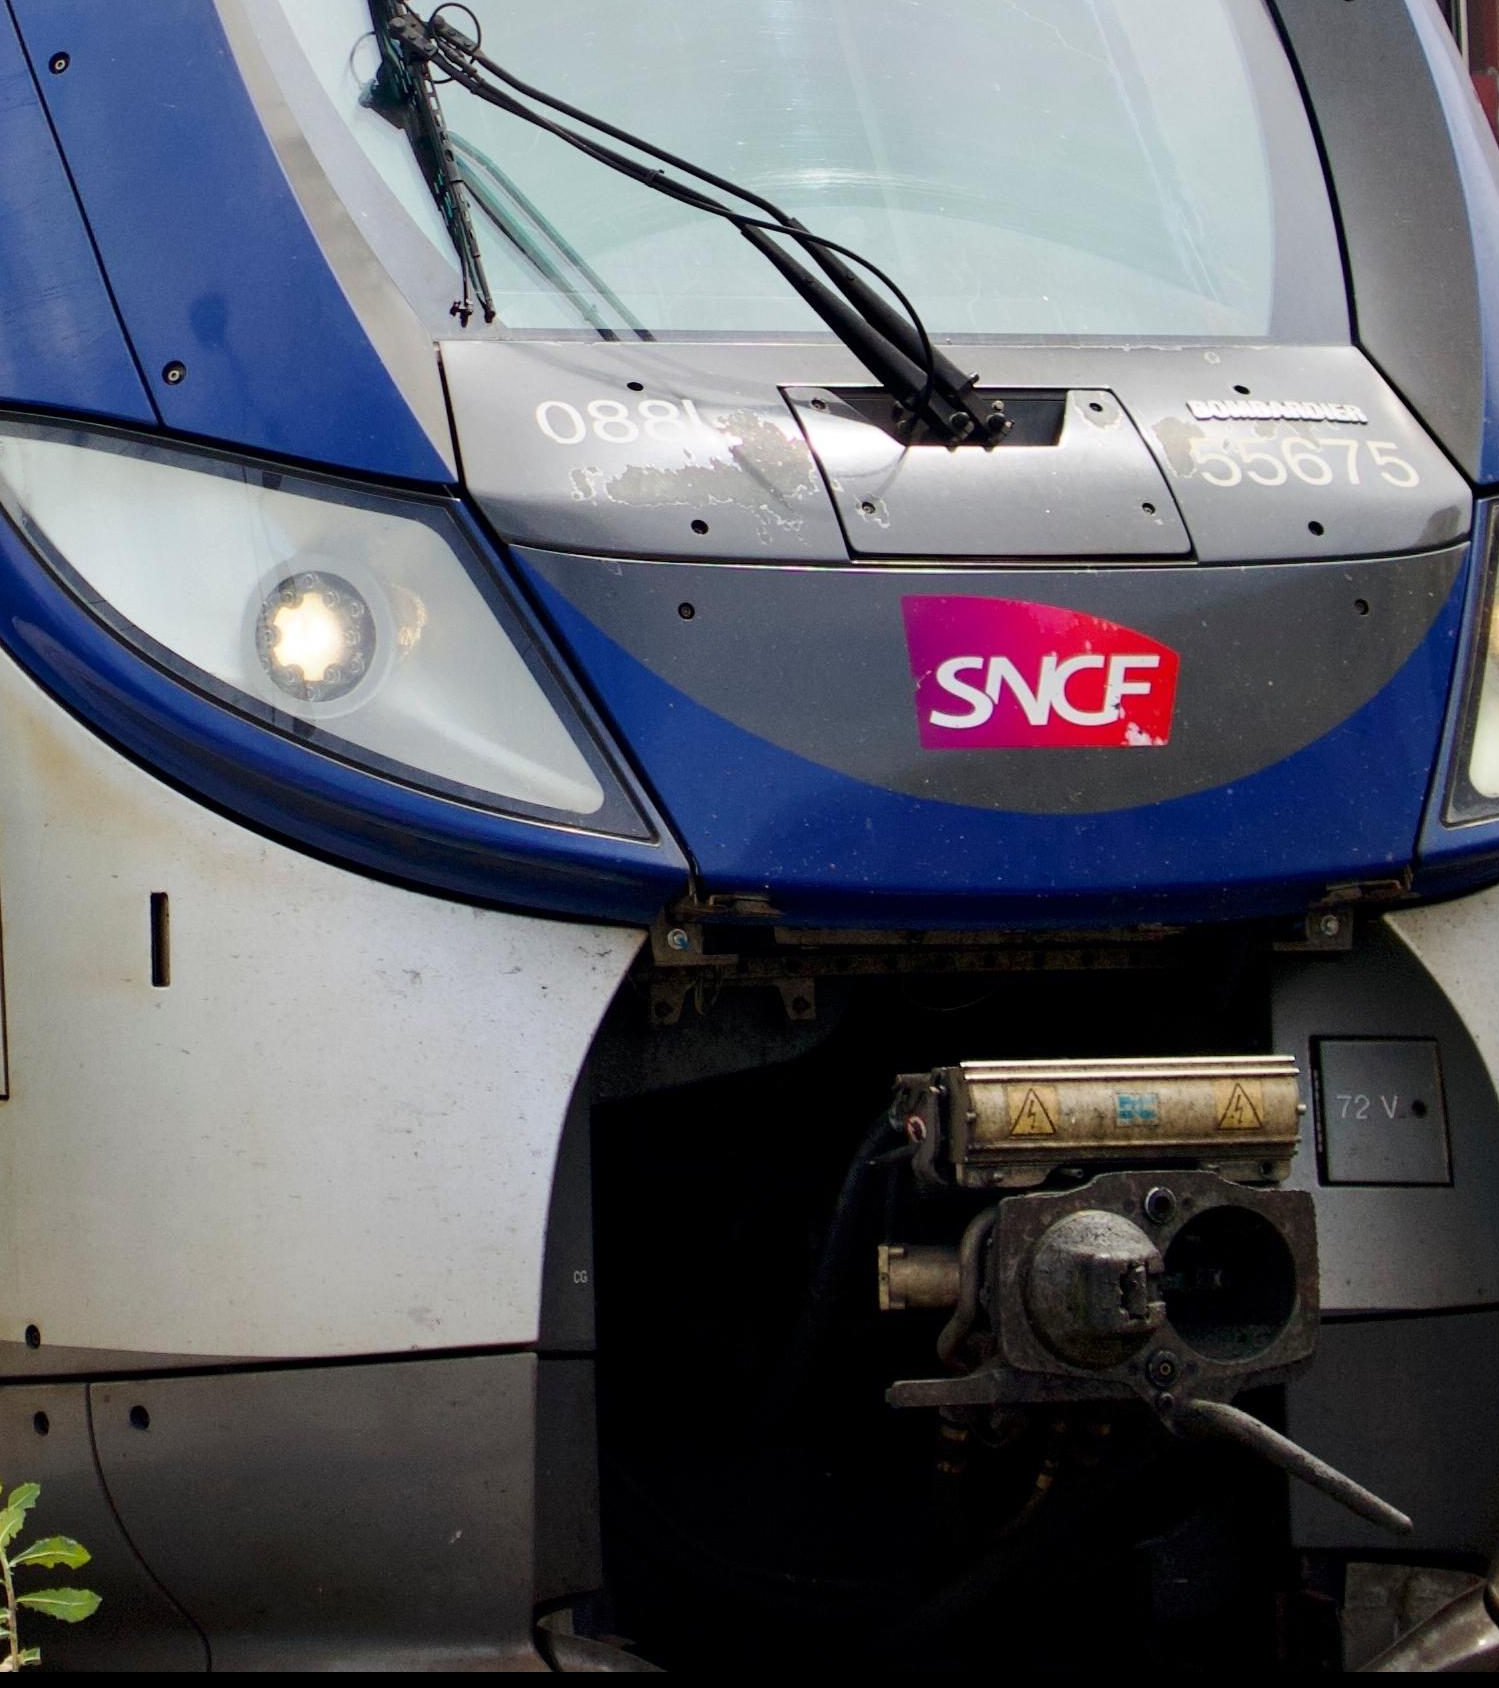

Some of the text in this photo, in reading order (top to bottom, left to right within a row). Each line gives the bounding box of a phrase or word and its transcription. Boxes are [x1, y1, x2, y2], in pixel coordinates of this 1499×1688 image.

[1187, 400, 1368, 425] BOMBARDIER
[1189, 437, 1420, 488] 55675
[929, 654, 1160, 729] SNCF
[1335, 1094, 1398, 1120] 72 V
